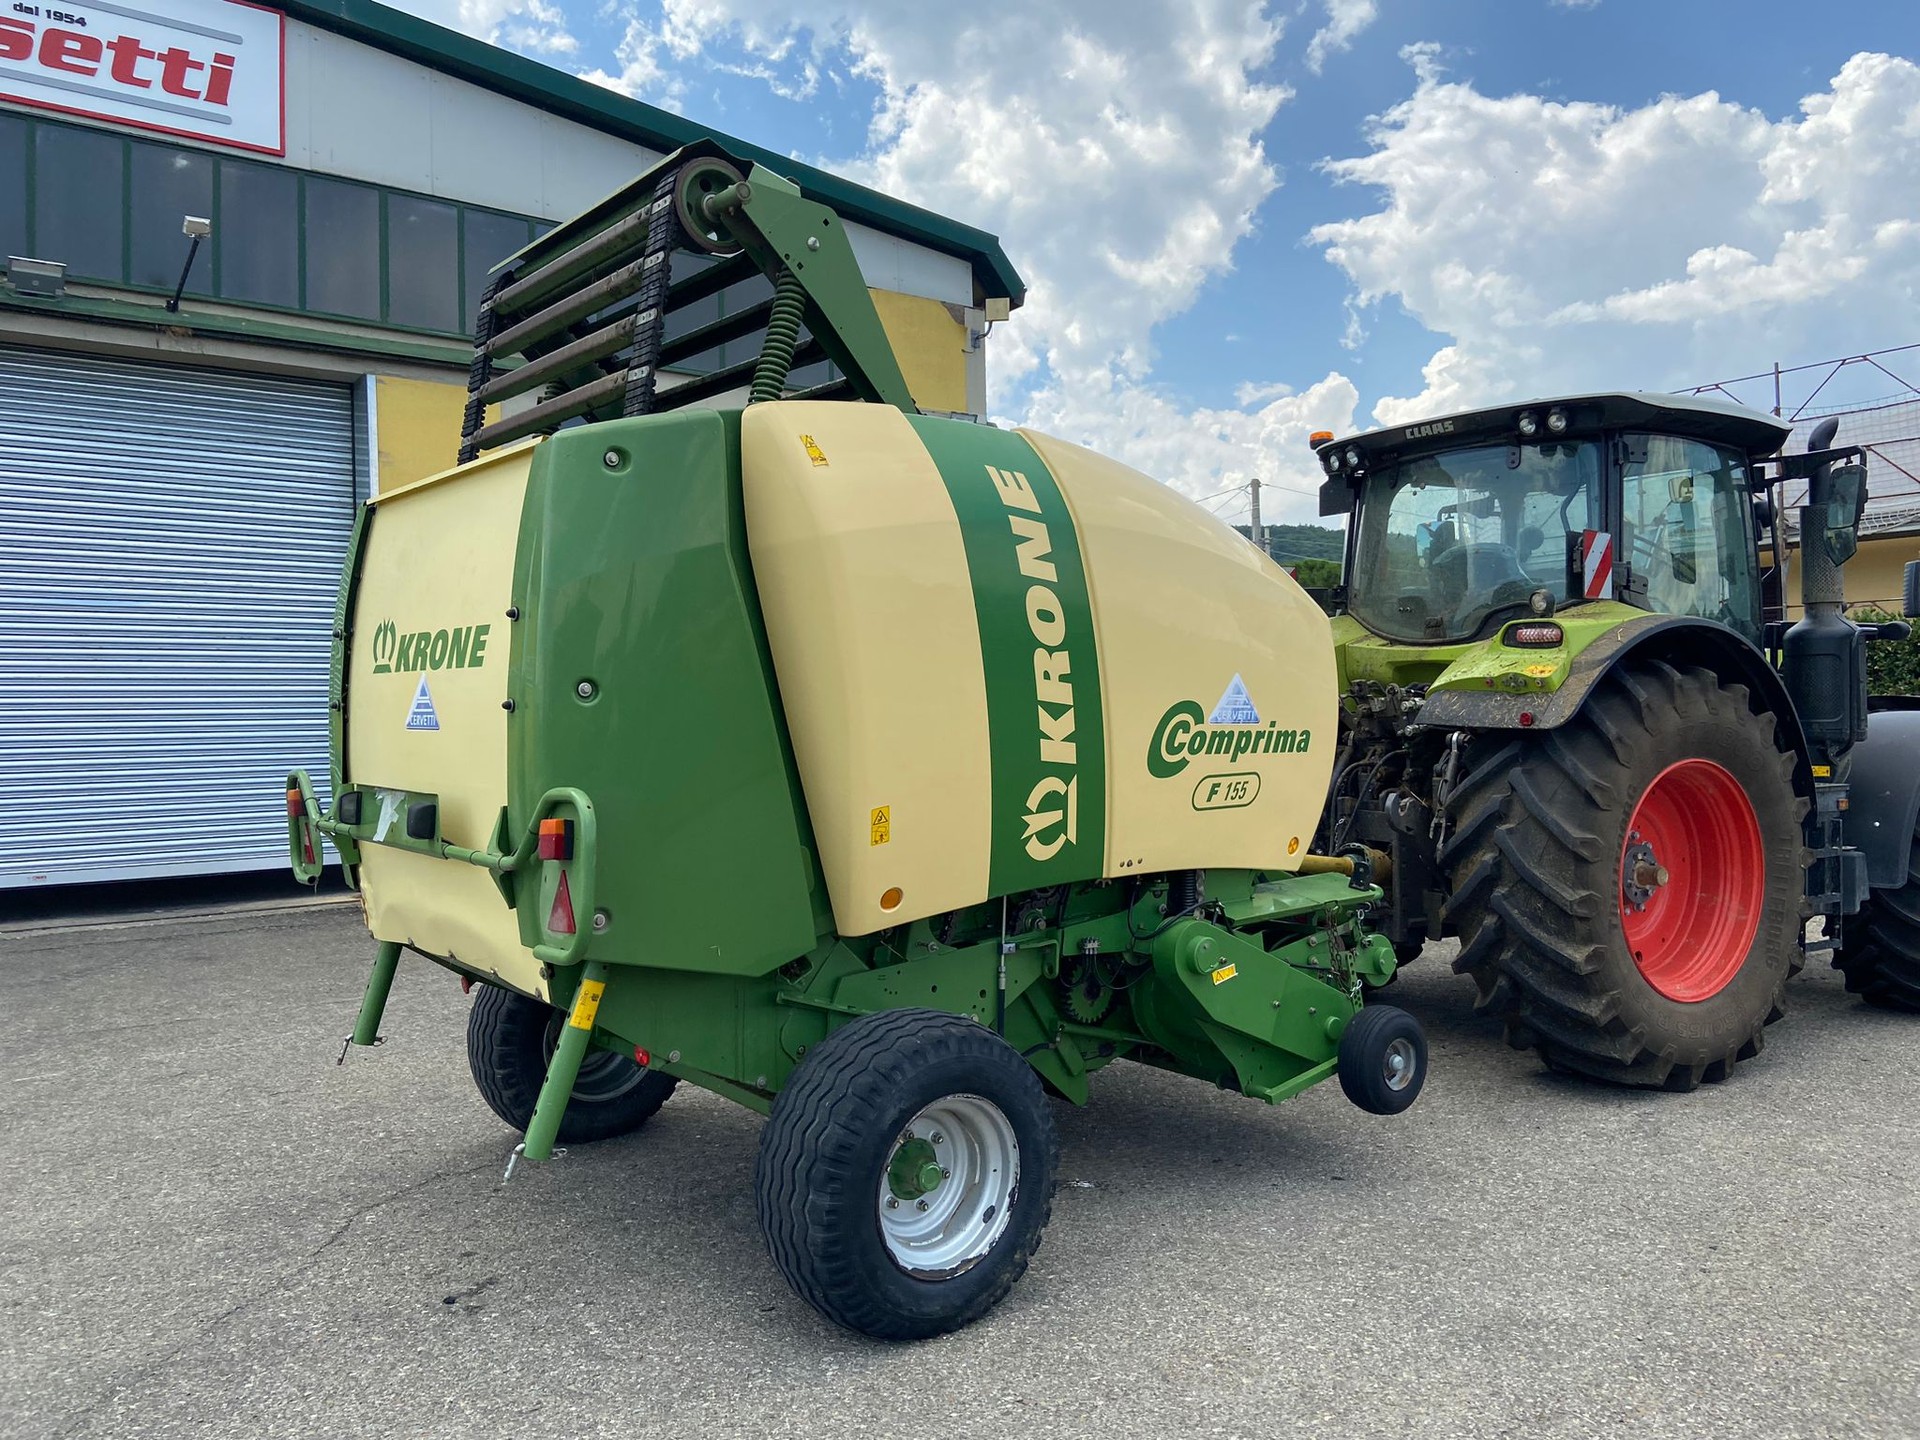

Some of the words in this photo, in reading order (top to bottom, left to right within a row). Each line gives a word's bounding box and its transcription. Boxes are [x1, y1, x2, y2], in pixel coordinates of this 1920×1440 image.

[13, 2, 39, 17] dal
[45, 9, 87, 27] 1954
[1405, 420, 1454, 440] CLAAS
[984, 464, 1077, 765] KRONE
[395, 624, 491, 673] KRONE
[410, 715, 436, 726] CERVETTI
[1217, 710, 1255, 721] CERVETTI
[1206, 782, 1221, 803] F
[1224, 781, 1249, 801] 155
